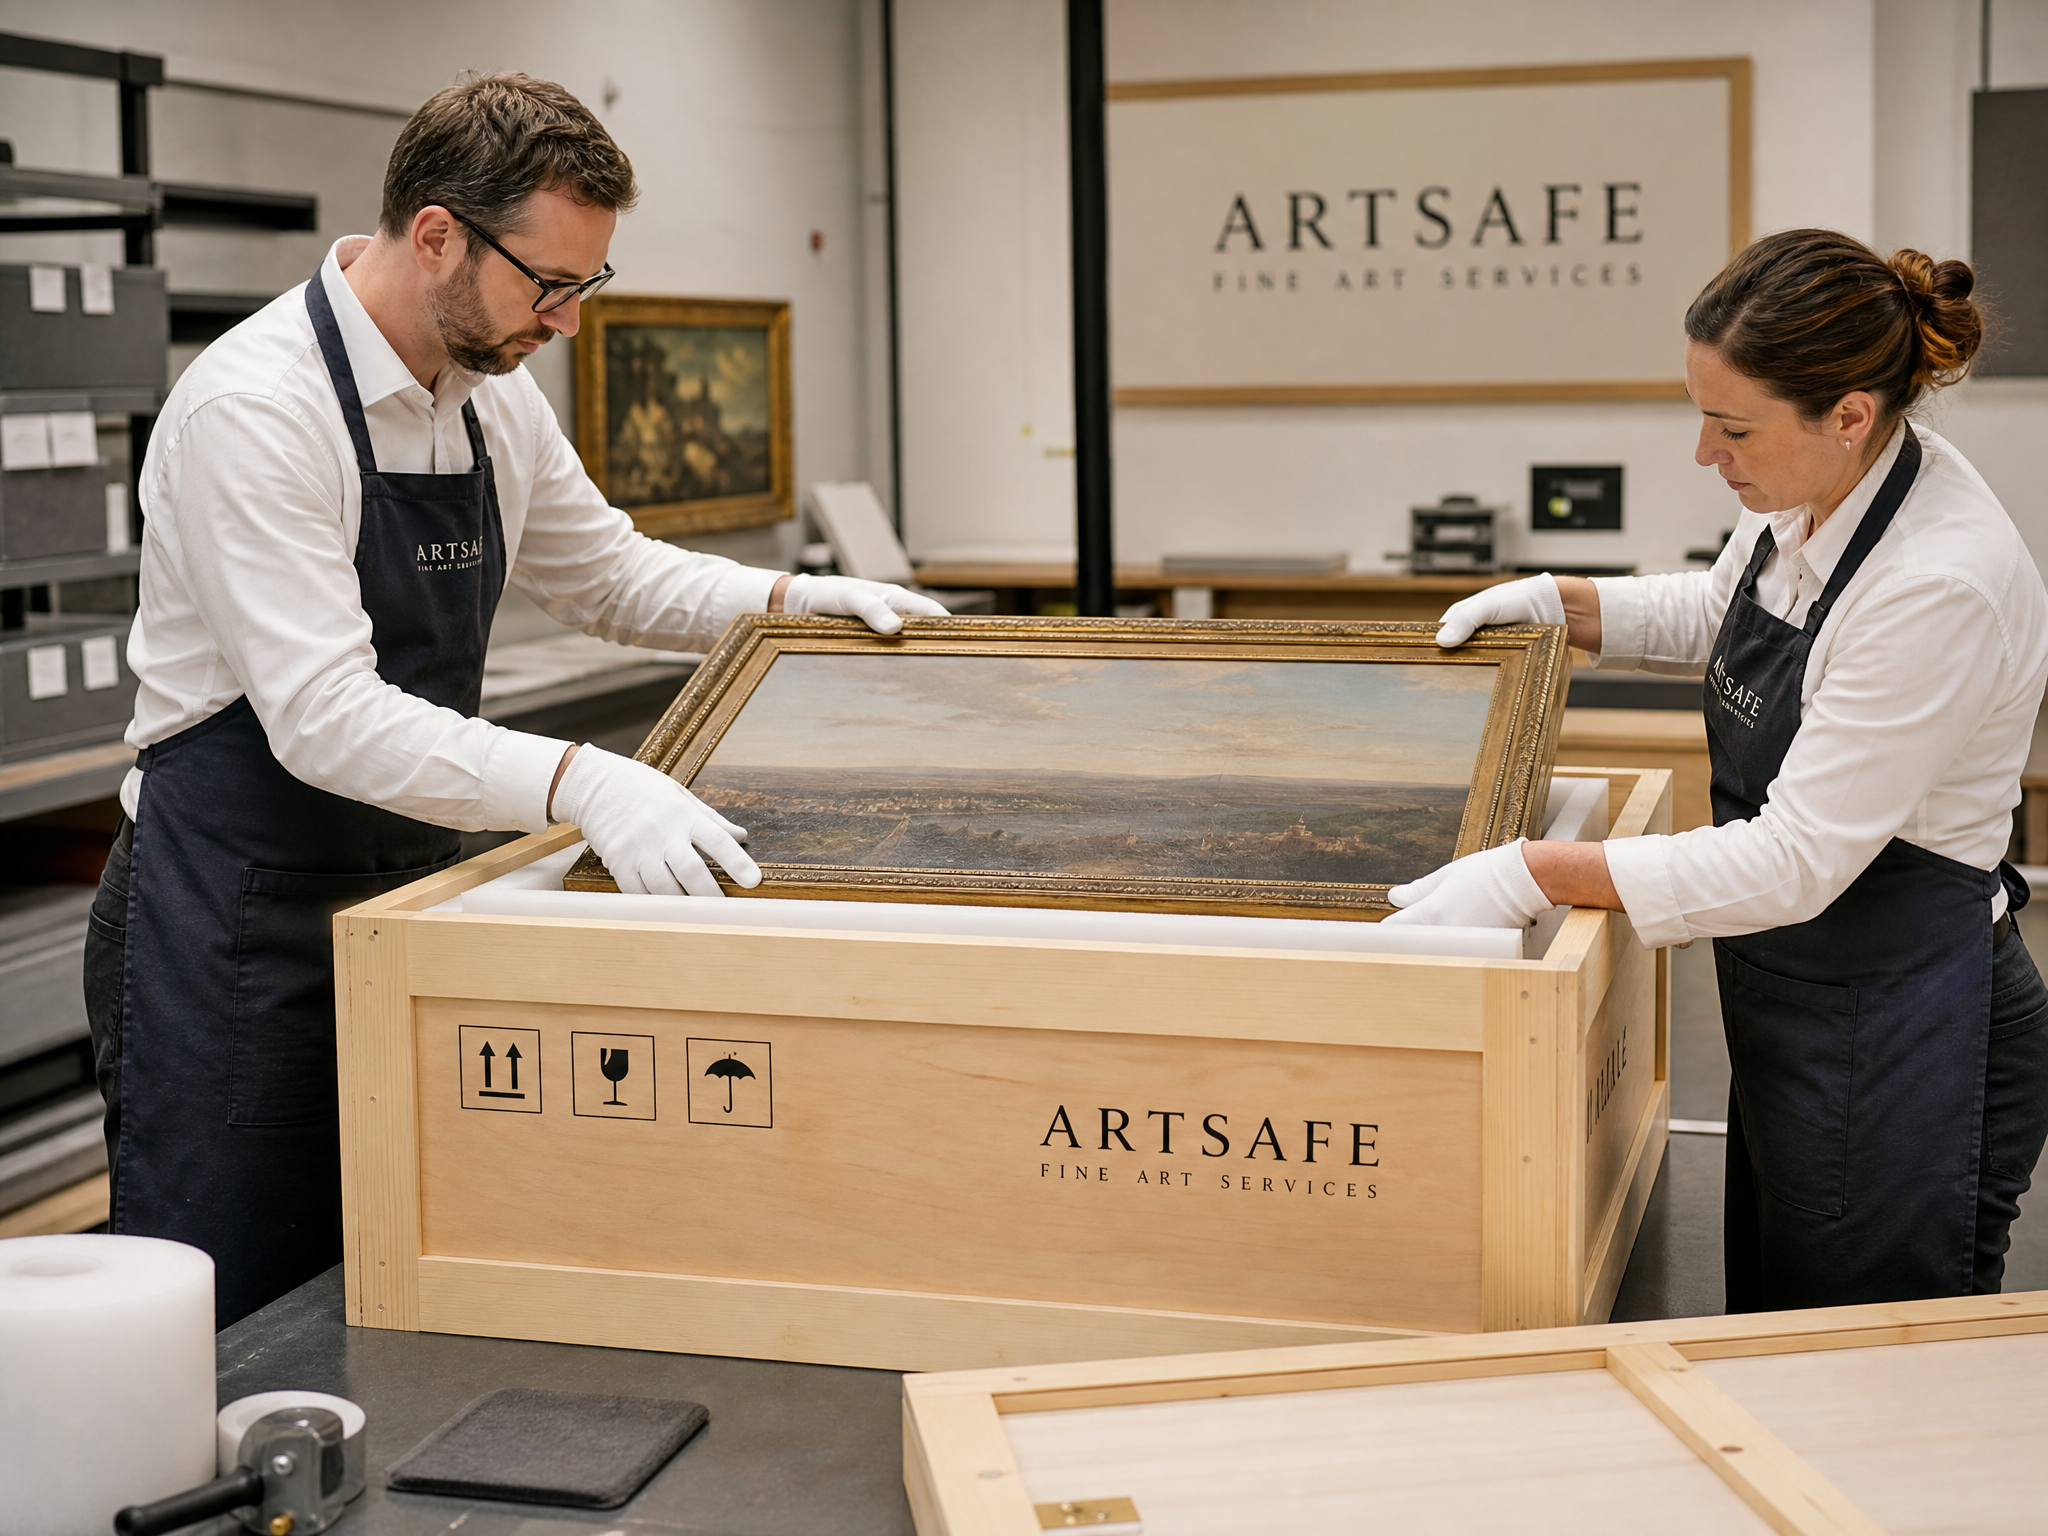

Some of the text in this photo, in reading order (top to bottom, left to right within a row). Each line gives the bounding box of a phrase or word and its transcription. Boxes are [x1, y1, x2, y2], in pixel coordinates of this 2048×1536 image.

[1213, 181, 1643, 253] ARTSAFE
[1212, 262, 1642, 293] FINE ART SERVICES
[1039, 1104, 1380, 1167] ARTSAFE
[1040, 1163, 1377, 1199] FINE ART SERVICES
